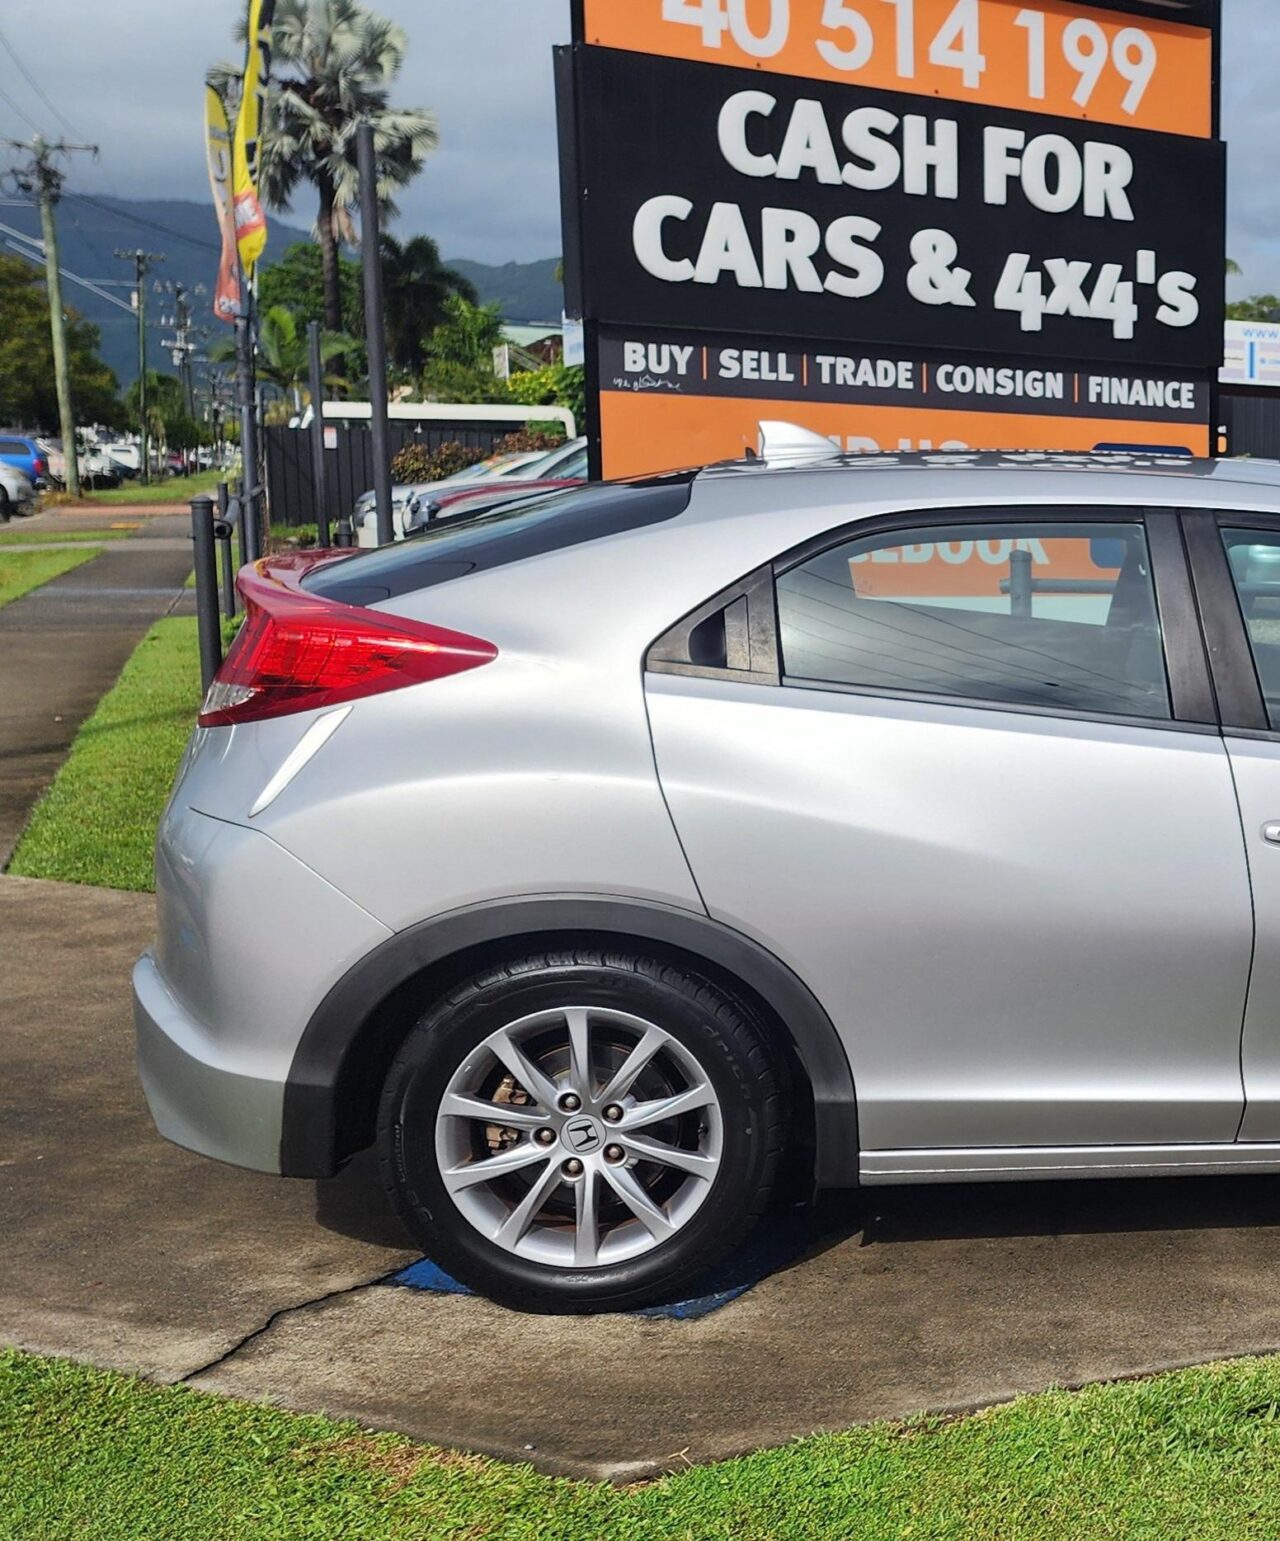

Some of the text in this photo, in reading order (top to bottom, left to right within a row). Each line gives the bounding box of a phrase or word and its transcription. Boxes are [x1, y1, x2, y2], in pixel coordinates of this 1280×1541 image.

[815, 0, 987, 89] 514
[1014, 9, 1158, 115] 199
[717, 90, 1135, 221] CASH FOR
[632, 194, 885, 298] CARS
[905, 228, 977, 307] &
[624, 341, 1195, 409] BUY SELL TRADE CONSIGN FINANCE
